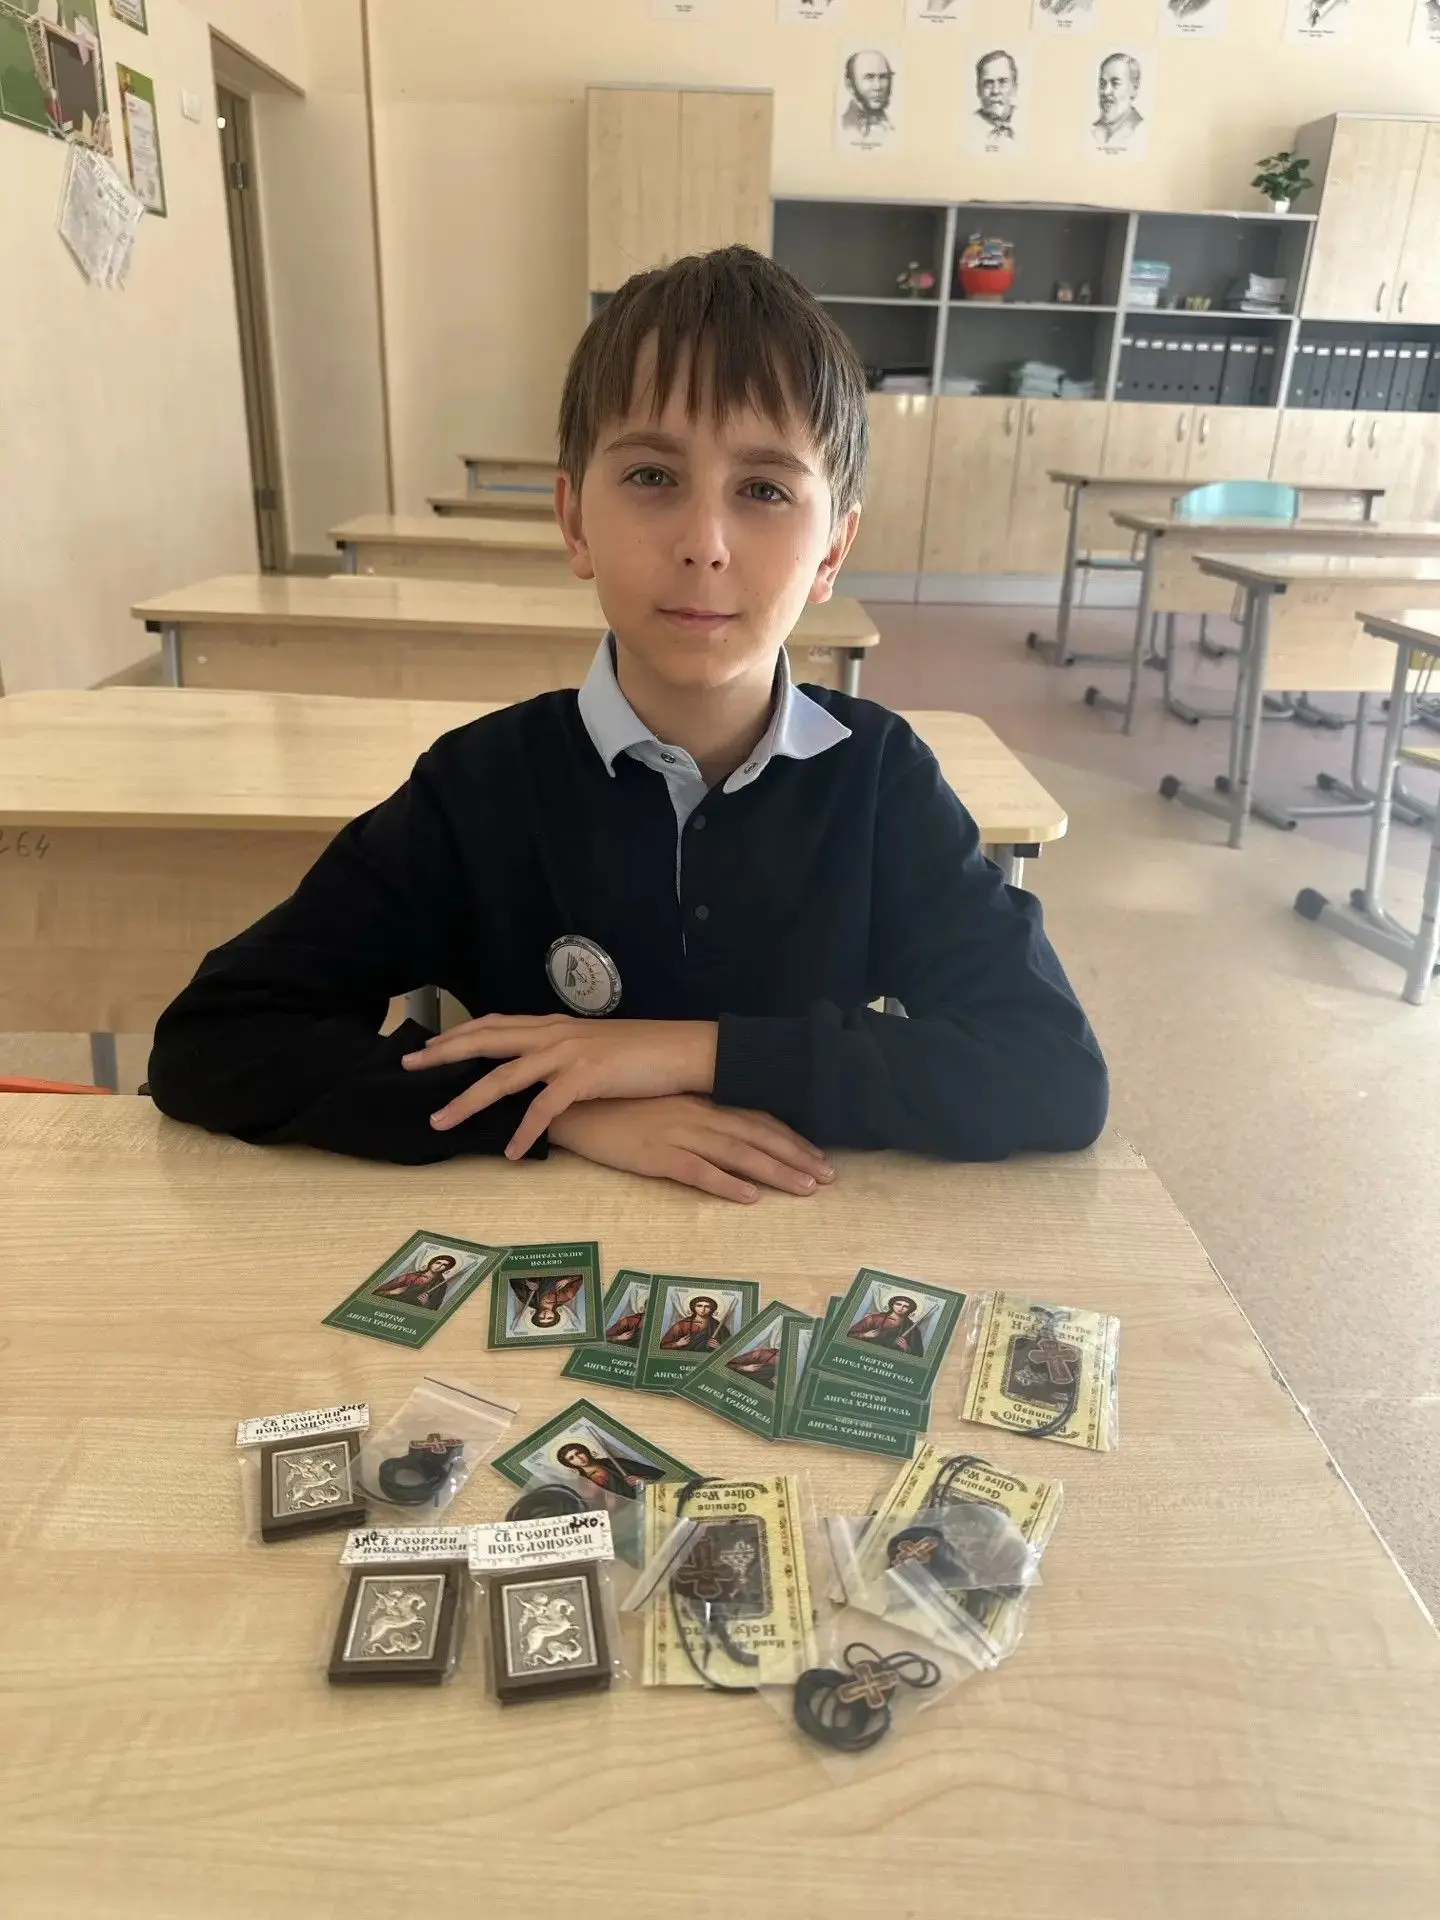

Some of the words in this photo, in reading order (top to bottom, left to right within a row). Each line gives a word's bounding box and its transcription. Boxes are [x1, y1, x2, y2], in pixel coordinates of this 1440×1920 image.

[584, 1361, 611, 1372] АНГЕЛ
[832, 1356, 861, 1369] АНГЕЛ
[863, 1363, 914, 1385] ХРАНИТЕЛЬ
[698, 1384, 724, 1399] АНГЕЛ
[725, 1396, 771, 1425] ХРАНИТЕЛЬ
[824, 1394, 853, 1406] АНГЕЛ
[856, 1400, 911, 1417] ХРАНИТЕЛЬ
[1003, 1411, 1032, 1425] Olive
[808, 1420, 838, 1432] АНГЕЛ
[840, 1426, 897, 1443] ХРАНИТЕЛЬ
[954, 1476, 1001, 1500] Genuine
[985, 1475, 1015, 1492] Olive
[724, 1489, 755, 1499] Olive
[697, 1502, 747, 1513] Genuine
